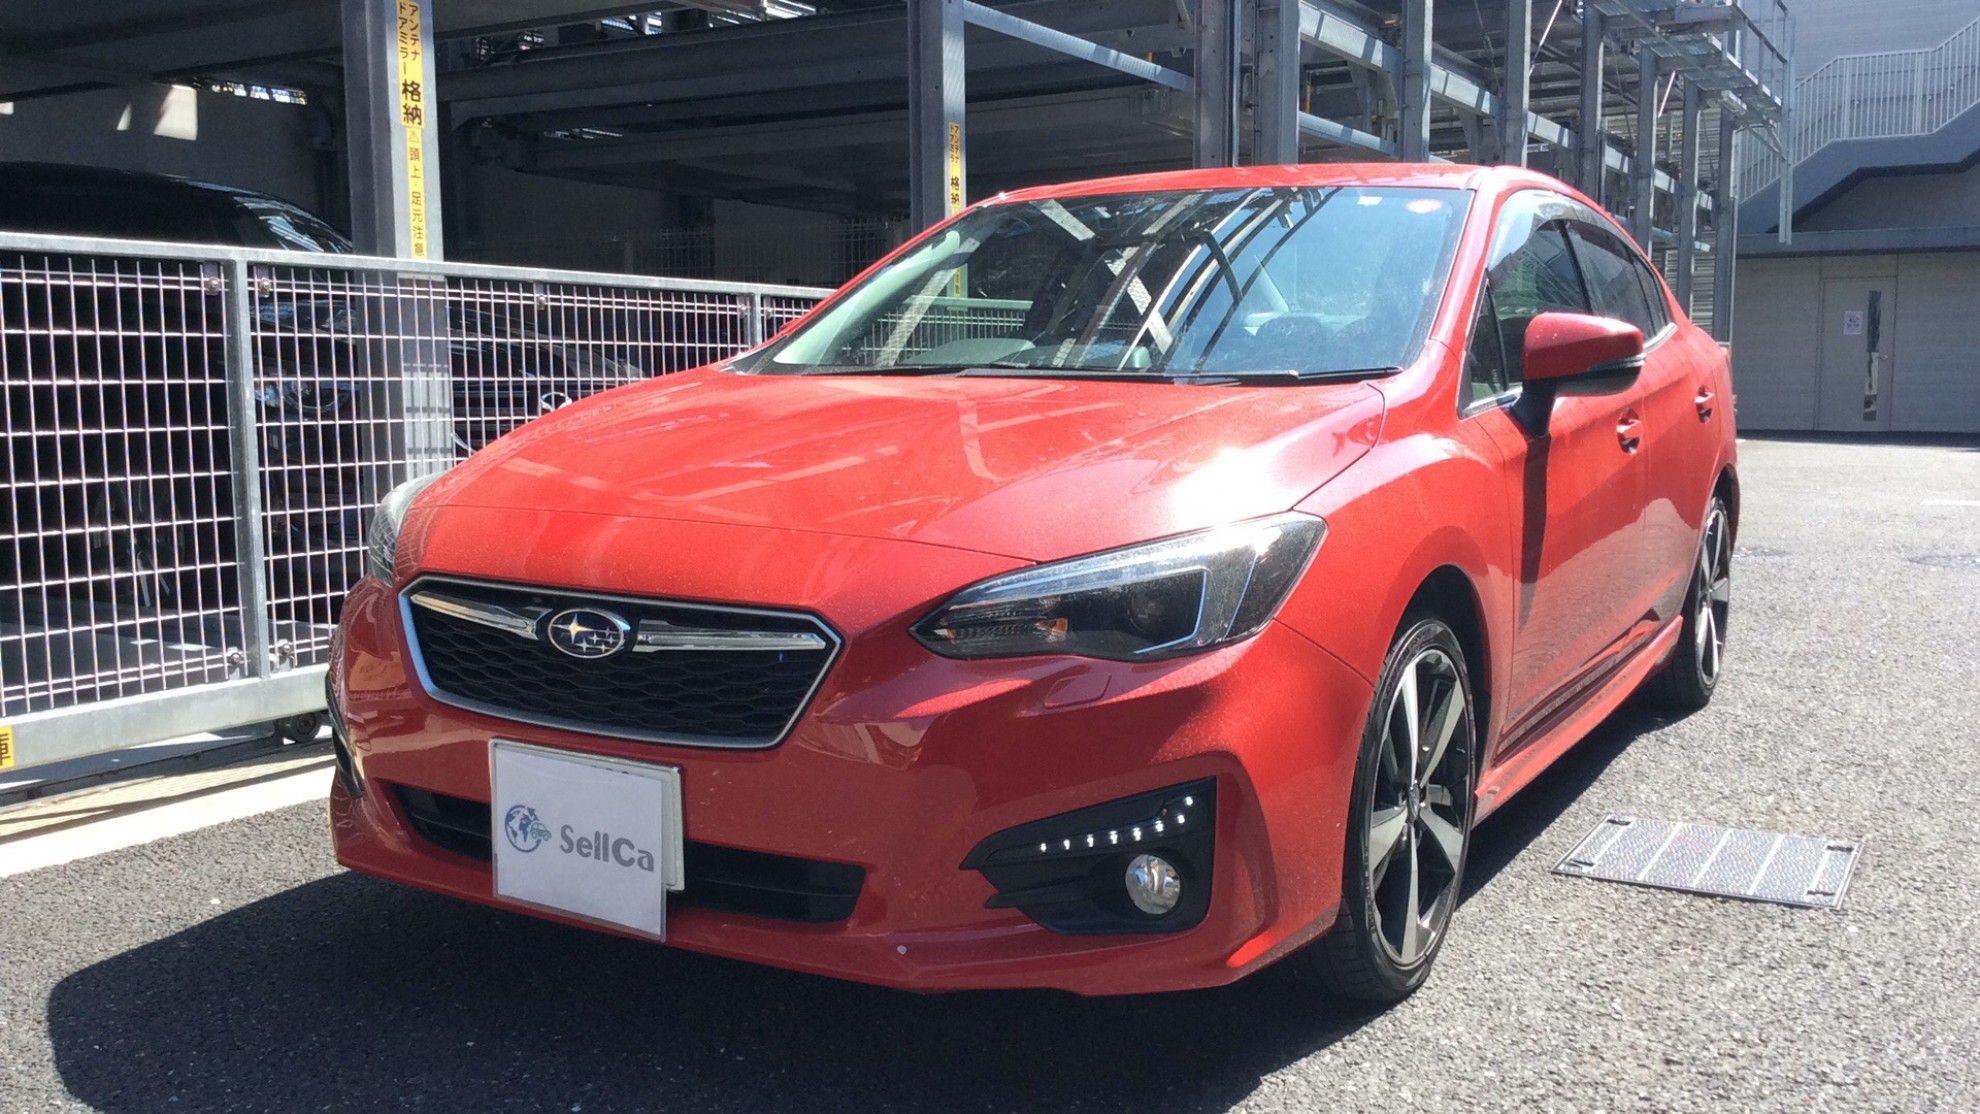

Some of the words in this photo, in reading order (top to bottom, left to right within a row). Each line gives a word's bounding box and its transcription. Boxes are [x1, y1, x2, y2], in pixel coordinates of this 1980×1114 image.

[398, 3, 409, 75] ドアミラー
[408, 4, 420, 61] アンテナ
[402, 79, 422, 126] 格納
[559, 824, 655, 873] SellCa
